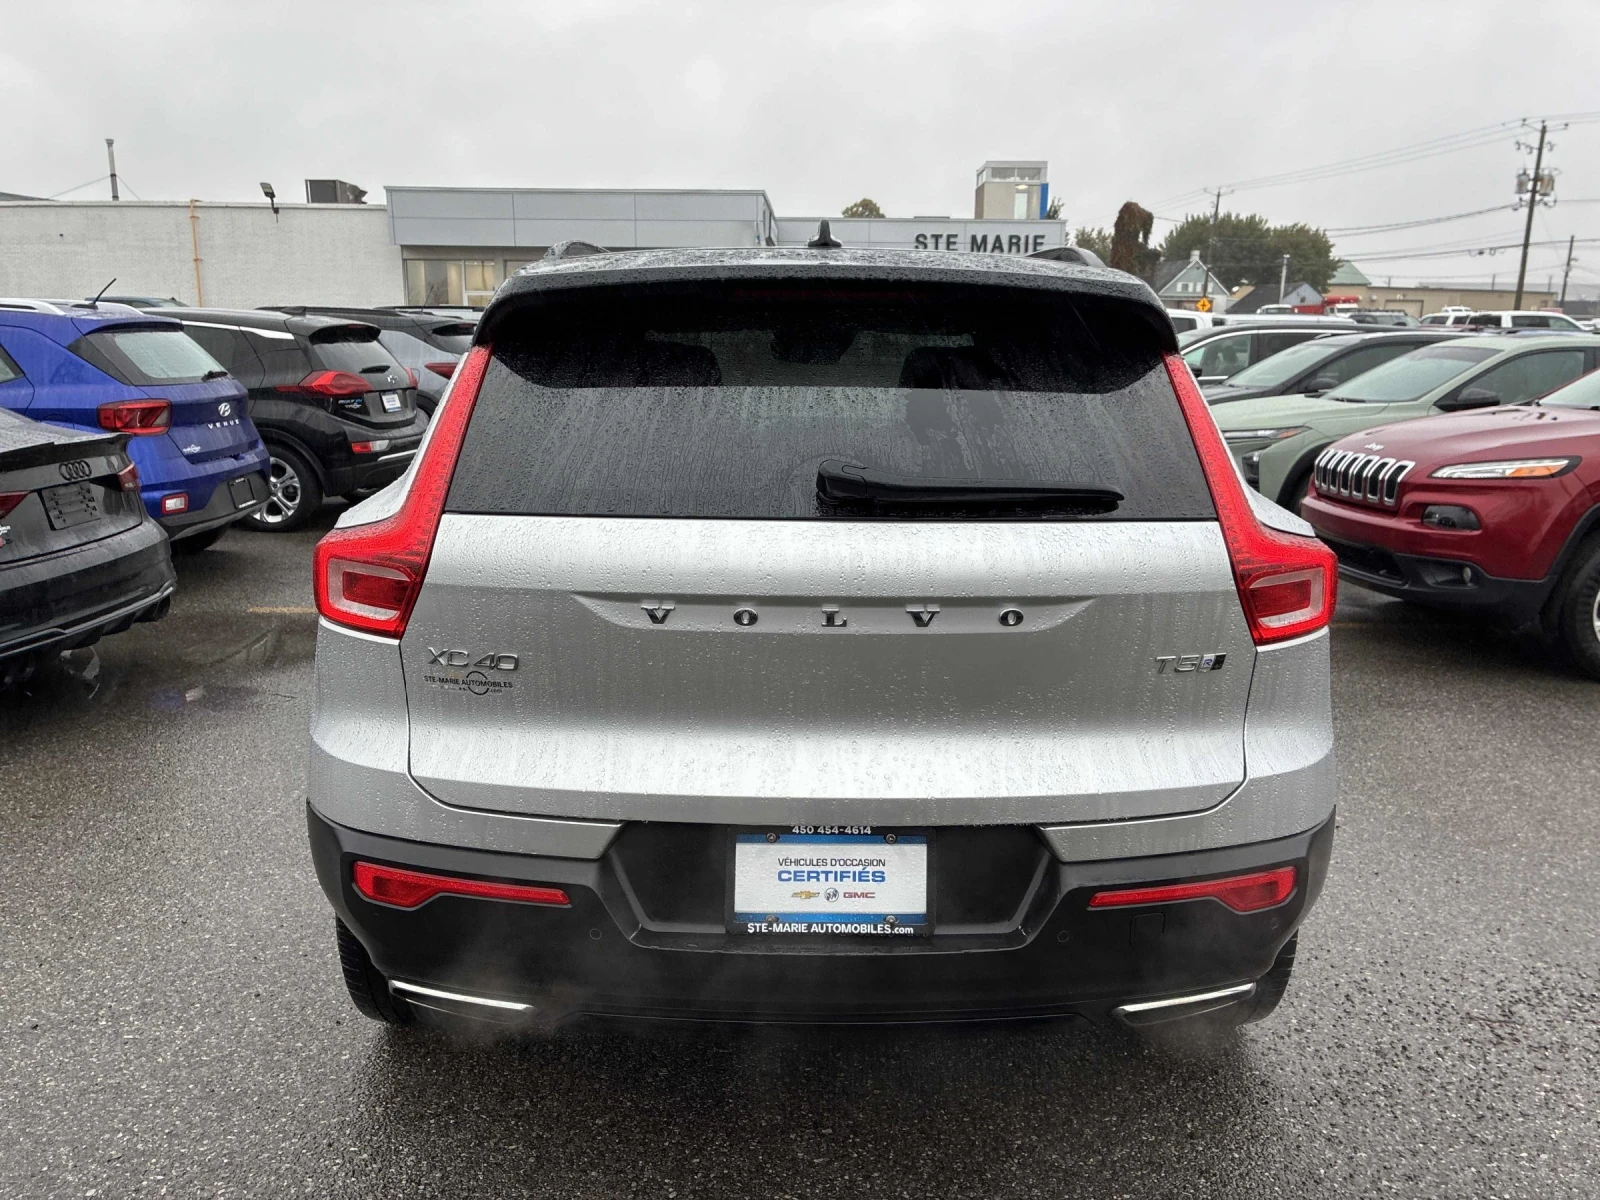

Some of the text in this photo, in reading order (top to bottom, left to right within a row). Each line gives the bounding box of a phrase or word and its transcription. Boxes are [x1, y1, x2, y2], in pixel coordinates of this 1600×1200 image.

[914, 233, 1046, 253] STE MARIE
[207, 419, 239, 430] VENUE
[641, 604, 1024, 627] VOLVO
[424, 675, 513, 689] STE-MARIE AUTOMOBILES
[792, 826, 872, 835] 450 454-4614
[777, 857, 886, 867] VÉHICULES D'OCCASION
[777, 867, 886, 883] CERTIFIÉS
[843, 891, 876, 899] GMC
[747, 923, 914, 935] STE-MARIE AUTOMOBILES.com
